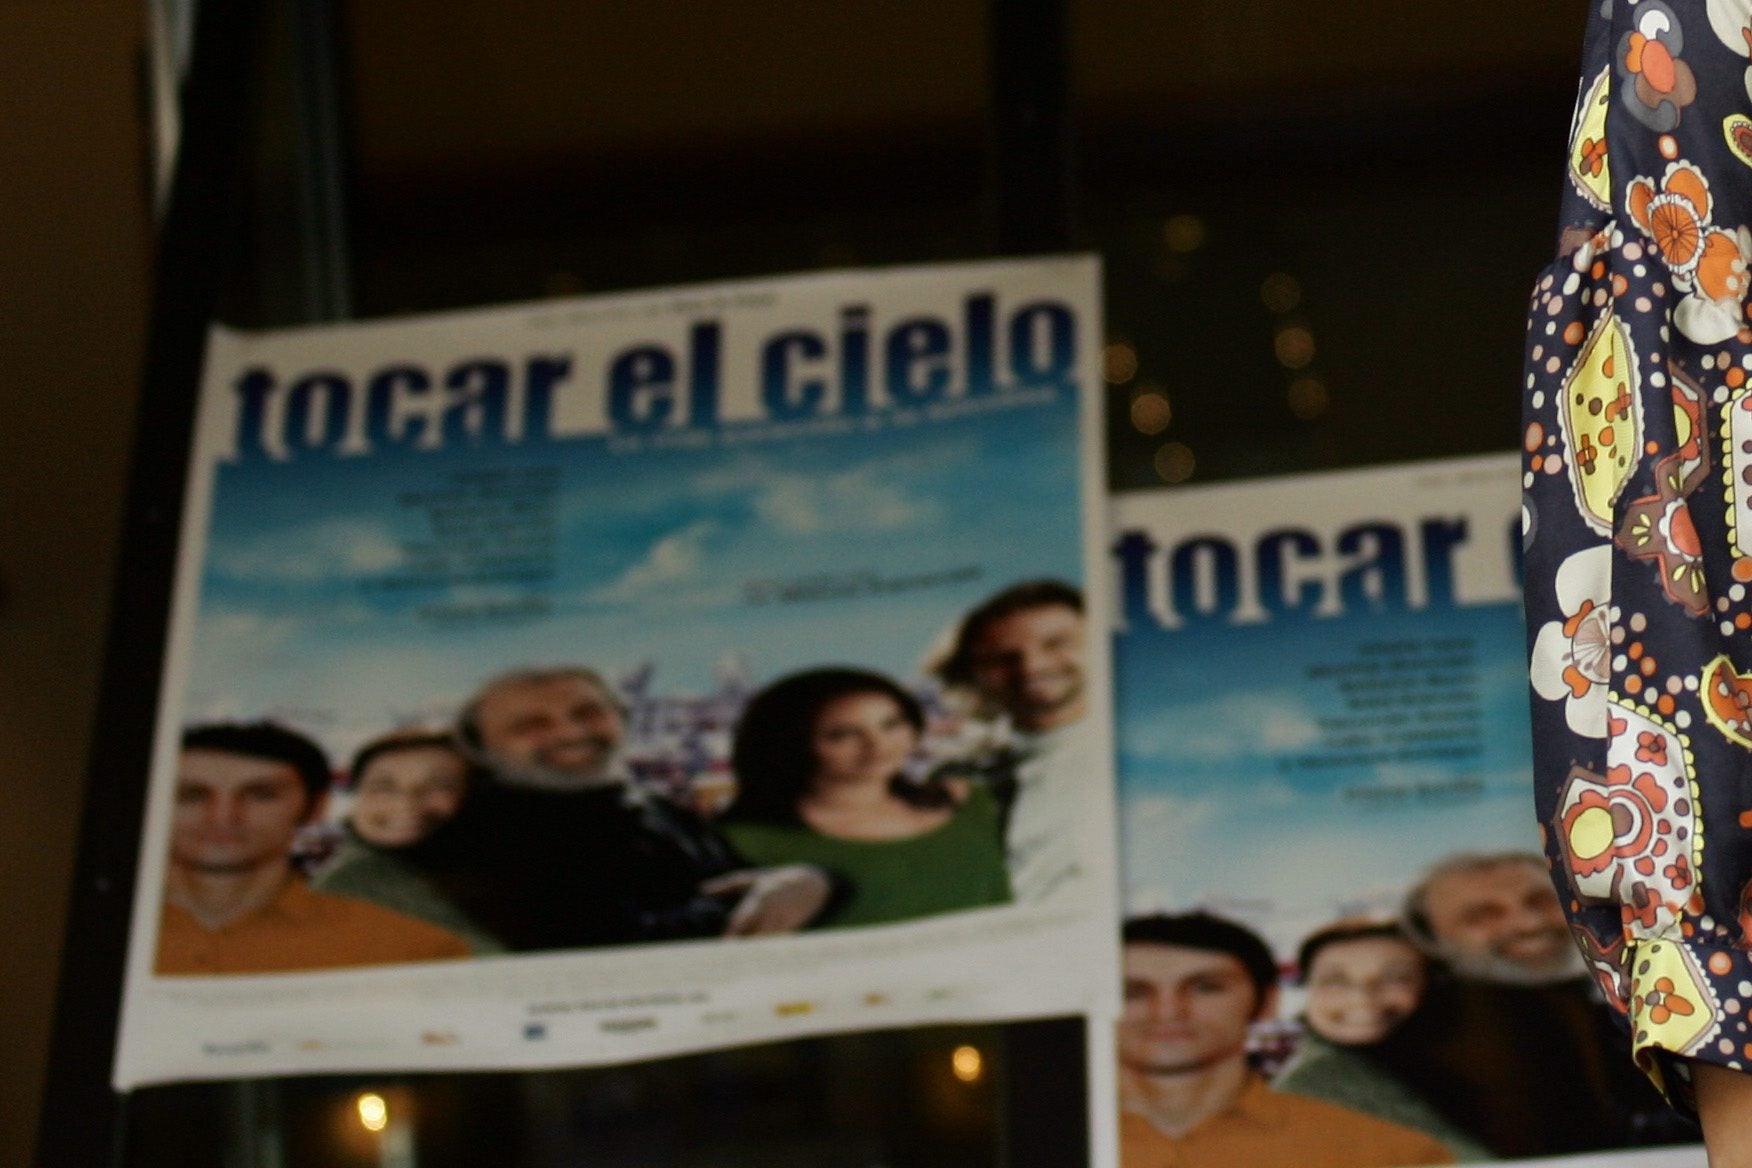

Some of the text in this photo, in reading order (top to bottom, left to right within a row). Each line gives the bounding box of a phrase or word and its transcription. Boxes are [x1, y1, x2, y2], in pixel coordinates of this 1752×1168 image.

[233, 352, 574, 462] tocar
[605, 321, 726, 434] el
[760, 292, 1079, 418] cielo
[1112, 513, 1470, 629] tocar
